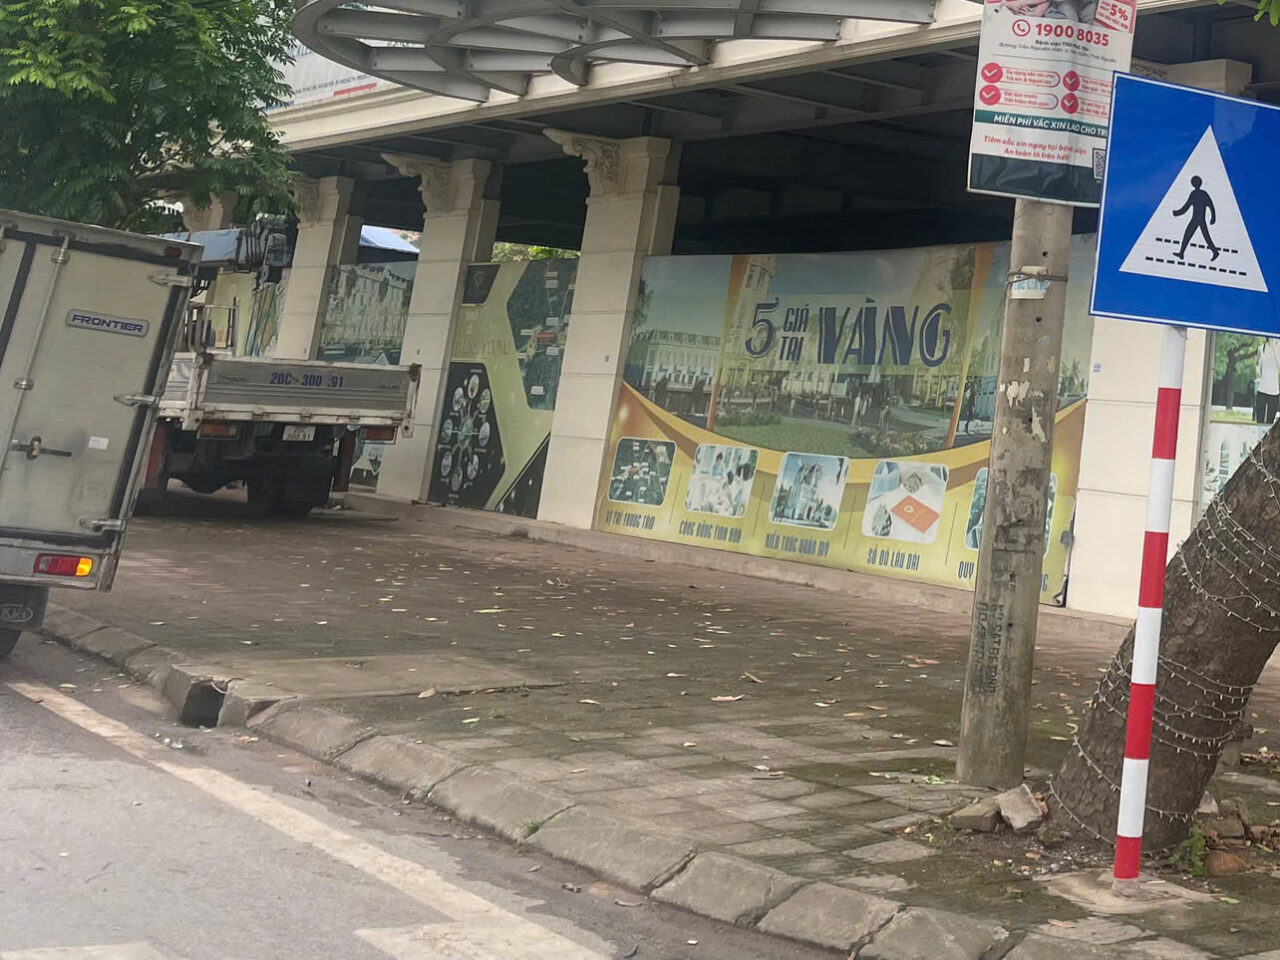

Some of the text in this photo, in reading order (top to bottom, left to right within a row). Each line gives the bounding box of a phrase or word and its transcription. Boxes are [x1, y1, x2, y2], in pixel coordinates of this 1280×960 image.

[1110, 4, 1129, 21] 5%
[1036, 23, 1109, 47] 1900 8035
[994, 114, 1015, 125] MIỄN
[1017, 115, 1032, 126] PHÍ
[1033, 116, 1049, 129] VẮC
[1050, 120, 1066, 130] XIN
[1067, 123, 1081, 132] LAO
[1081, 126, 1096, 135] CHO
[984, 135, 1001, 144] Tiêm
[1004, 147, 1014, 155] An
[71, 314, 144, 333] FRONTIER
[784, 303, 810, 333] GIÁ
[745, 296, 953, 368] 5 VÀNG
[779, 335, 804, 366] TRỊ
